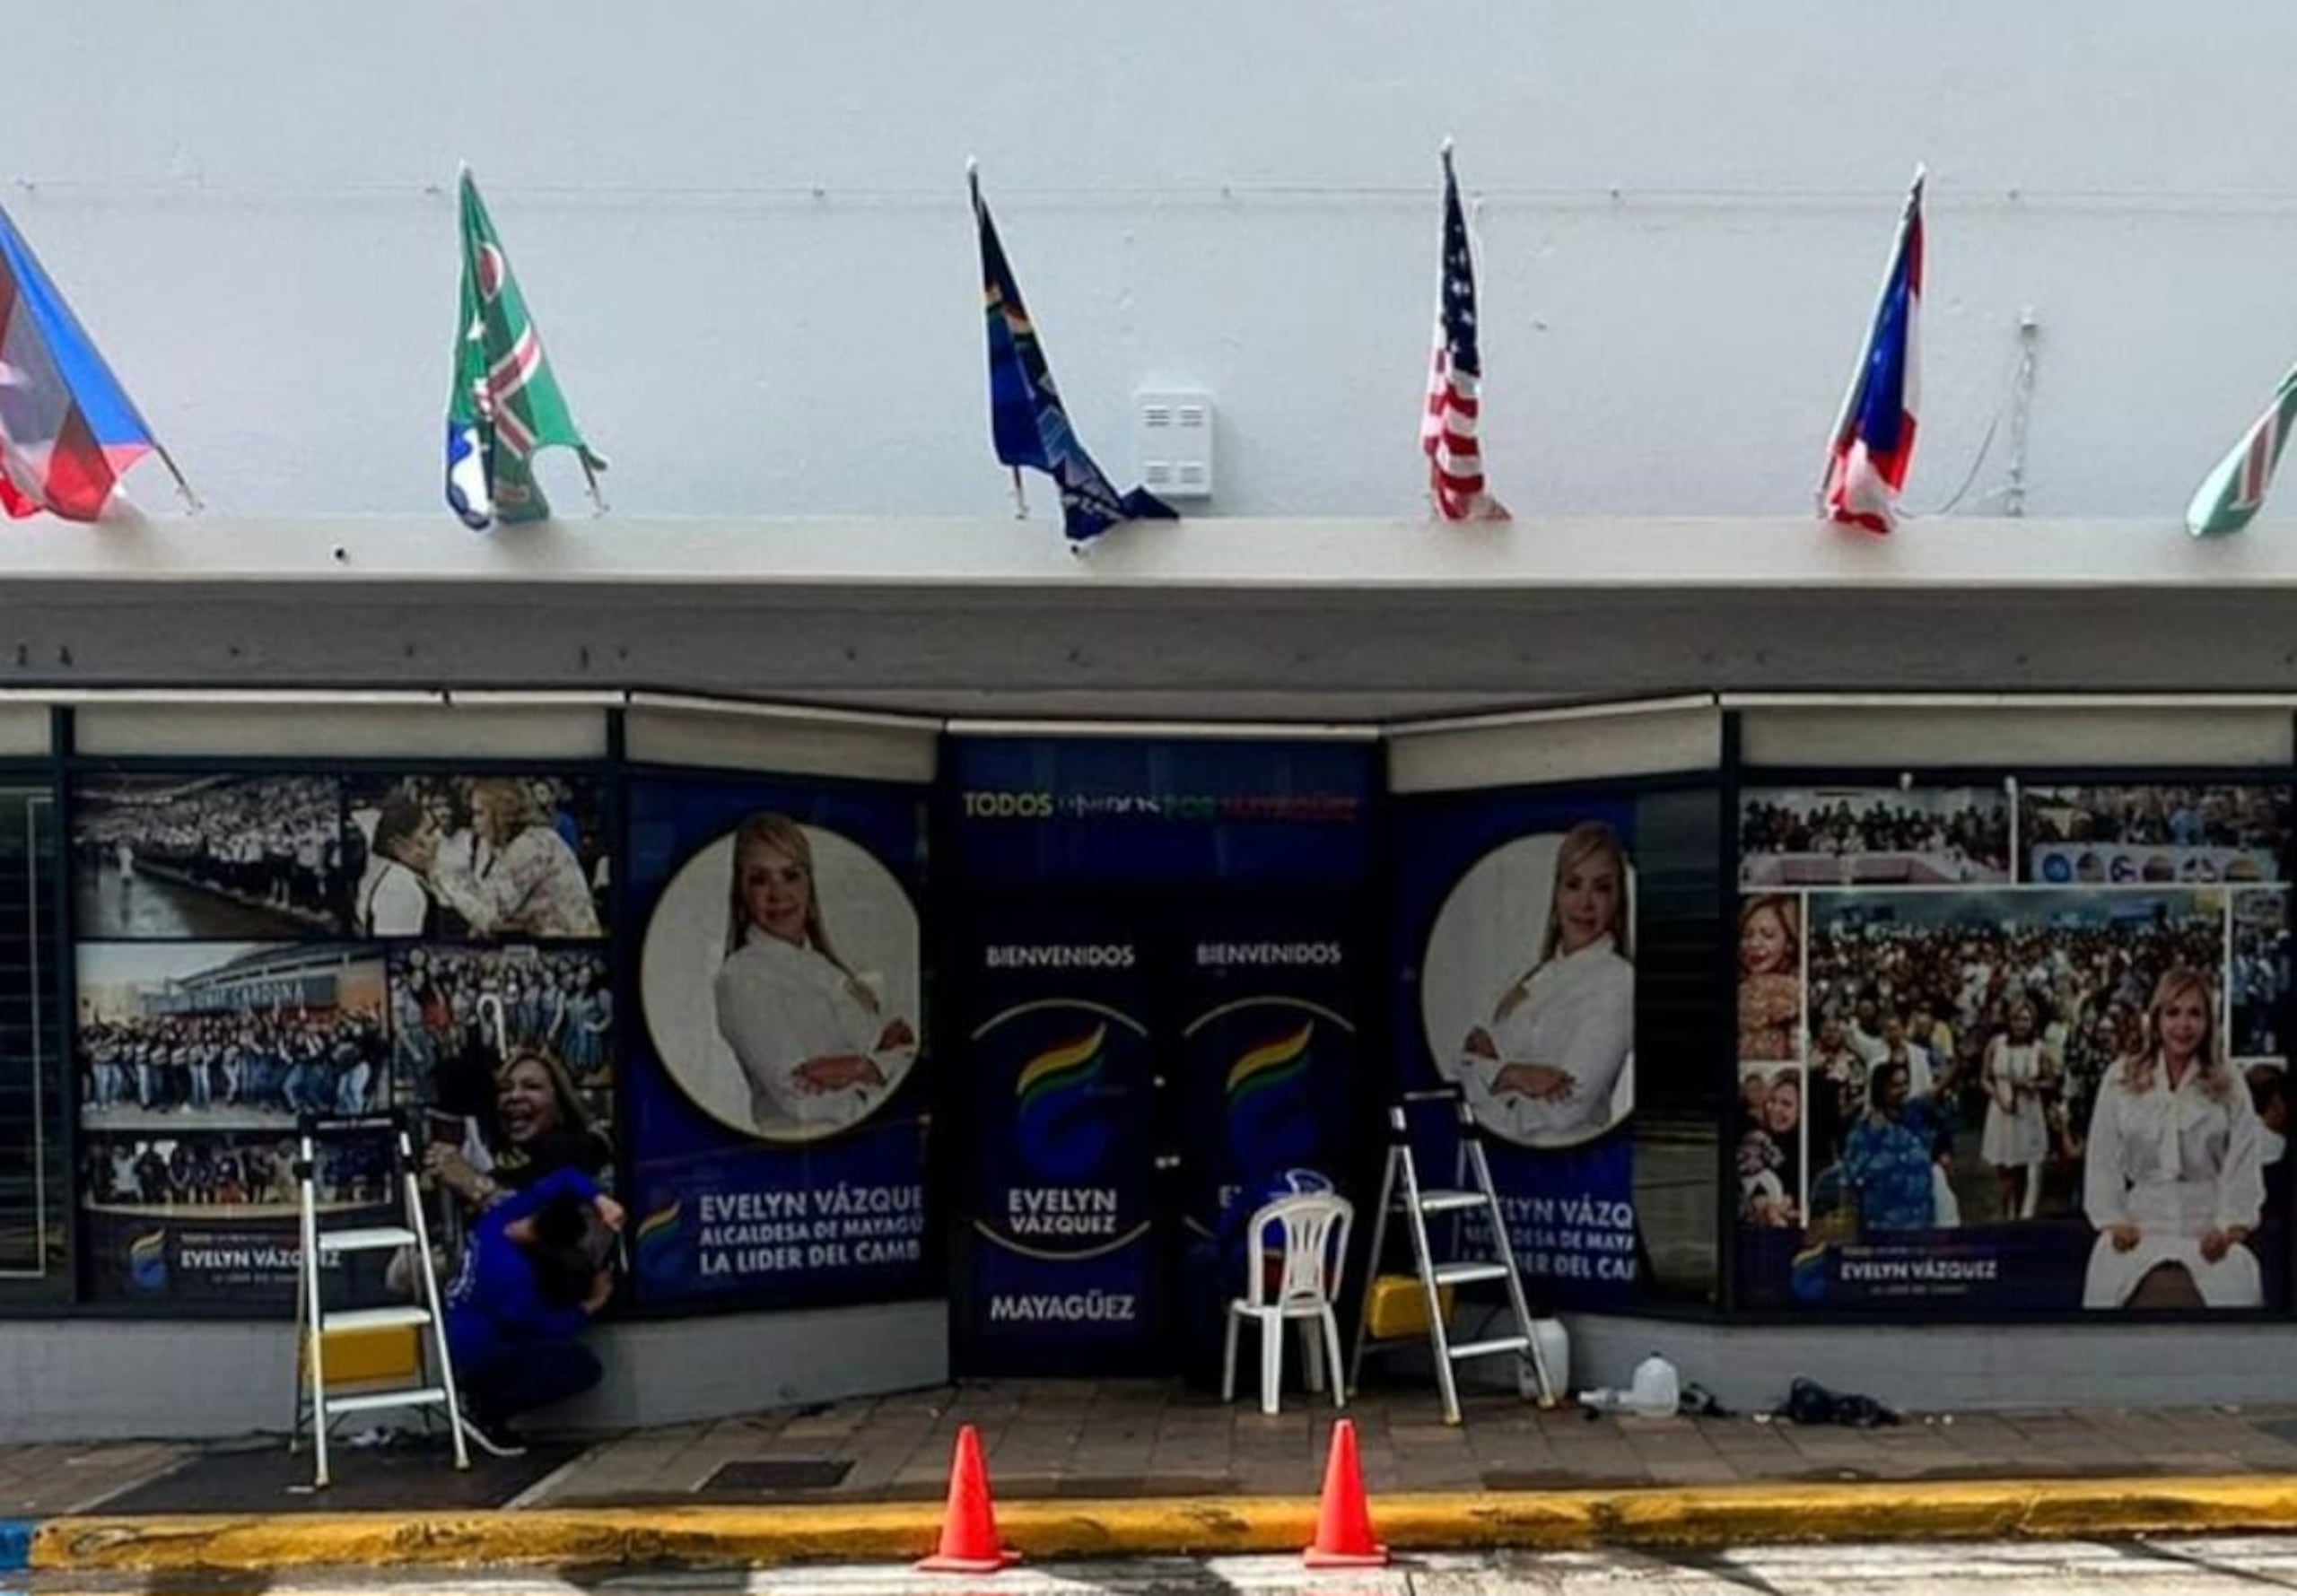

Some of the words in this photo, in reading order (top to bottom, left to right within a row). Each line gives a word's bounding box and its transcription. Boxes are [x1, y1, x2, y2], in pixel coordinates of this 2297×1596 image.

[962, 791, 1054, 818] TODOS
[985, 944, 1136, 968] BIENVENIDOS
[1196, 941, 1342, 965] BIENVENIDOS
[699, 1191, 808, 1223] EVELYN
[813, 1181, 923, 1215] VÁZQUE
[1008, 1188, 1118, 1213] EVELYN
[1559, 1191, 1634, 1228] VÁZQ
[699, 1221, 808, 1248] ALCALDESA
[811, 1219, 839, 1239] DE
[1559, 1229, 1583, 1250] DE
[181, 1250, 250, 1269] EVELYN
[699, 1252, 731, 1276] LA
[736, 1246, 803, 1274] LIDER
[808, 1243, 850, 1269] DEL
[1554, 1254, 1592, 1278] DEL
[1841, 1260, 1908, 1280] EVELYN
[1910, 1257, 1999, 1280] VÁZQUEZ
[990, 1289, 1136, 1321] MAYAGÜEZ
